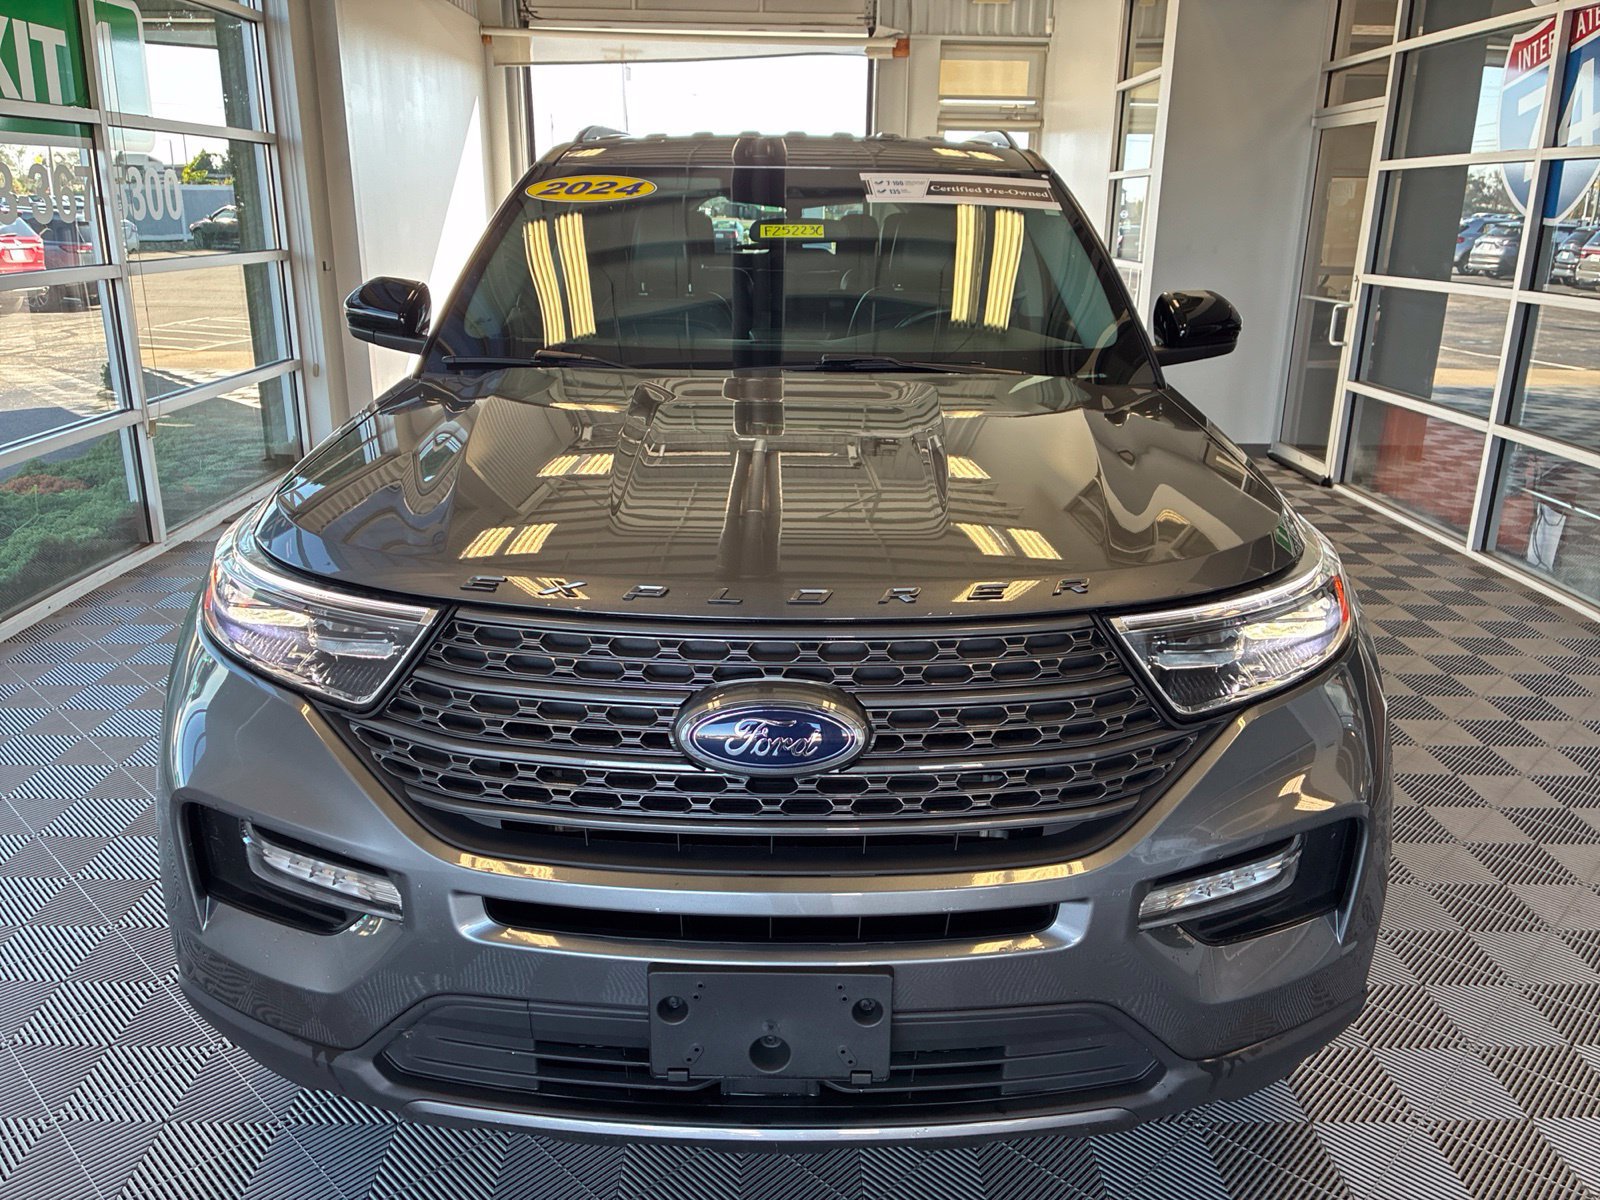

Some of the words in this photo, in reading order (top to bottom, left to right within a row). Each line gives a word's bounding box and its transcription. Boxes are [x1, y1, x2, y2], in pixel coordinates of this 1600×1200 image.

[536, 181, 646, 199] 2024
[930, 184, 982, 195] Certified
[985, 187, 1049, 198] Pre-Owned
[460, 575, 1091, 605] EXPLORER
[724, 718, 822, 757] Ford
